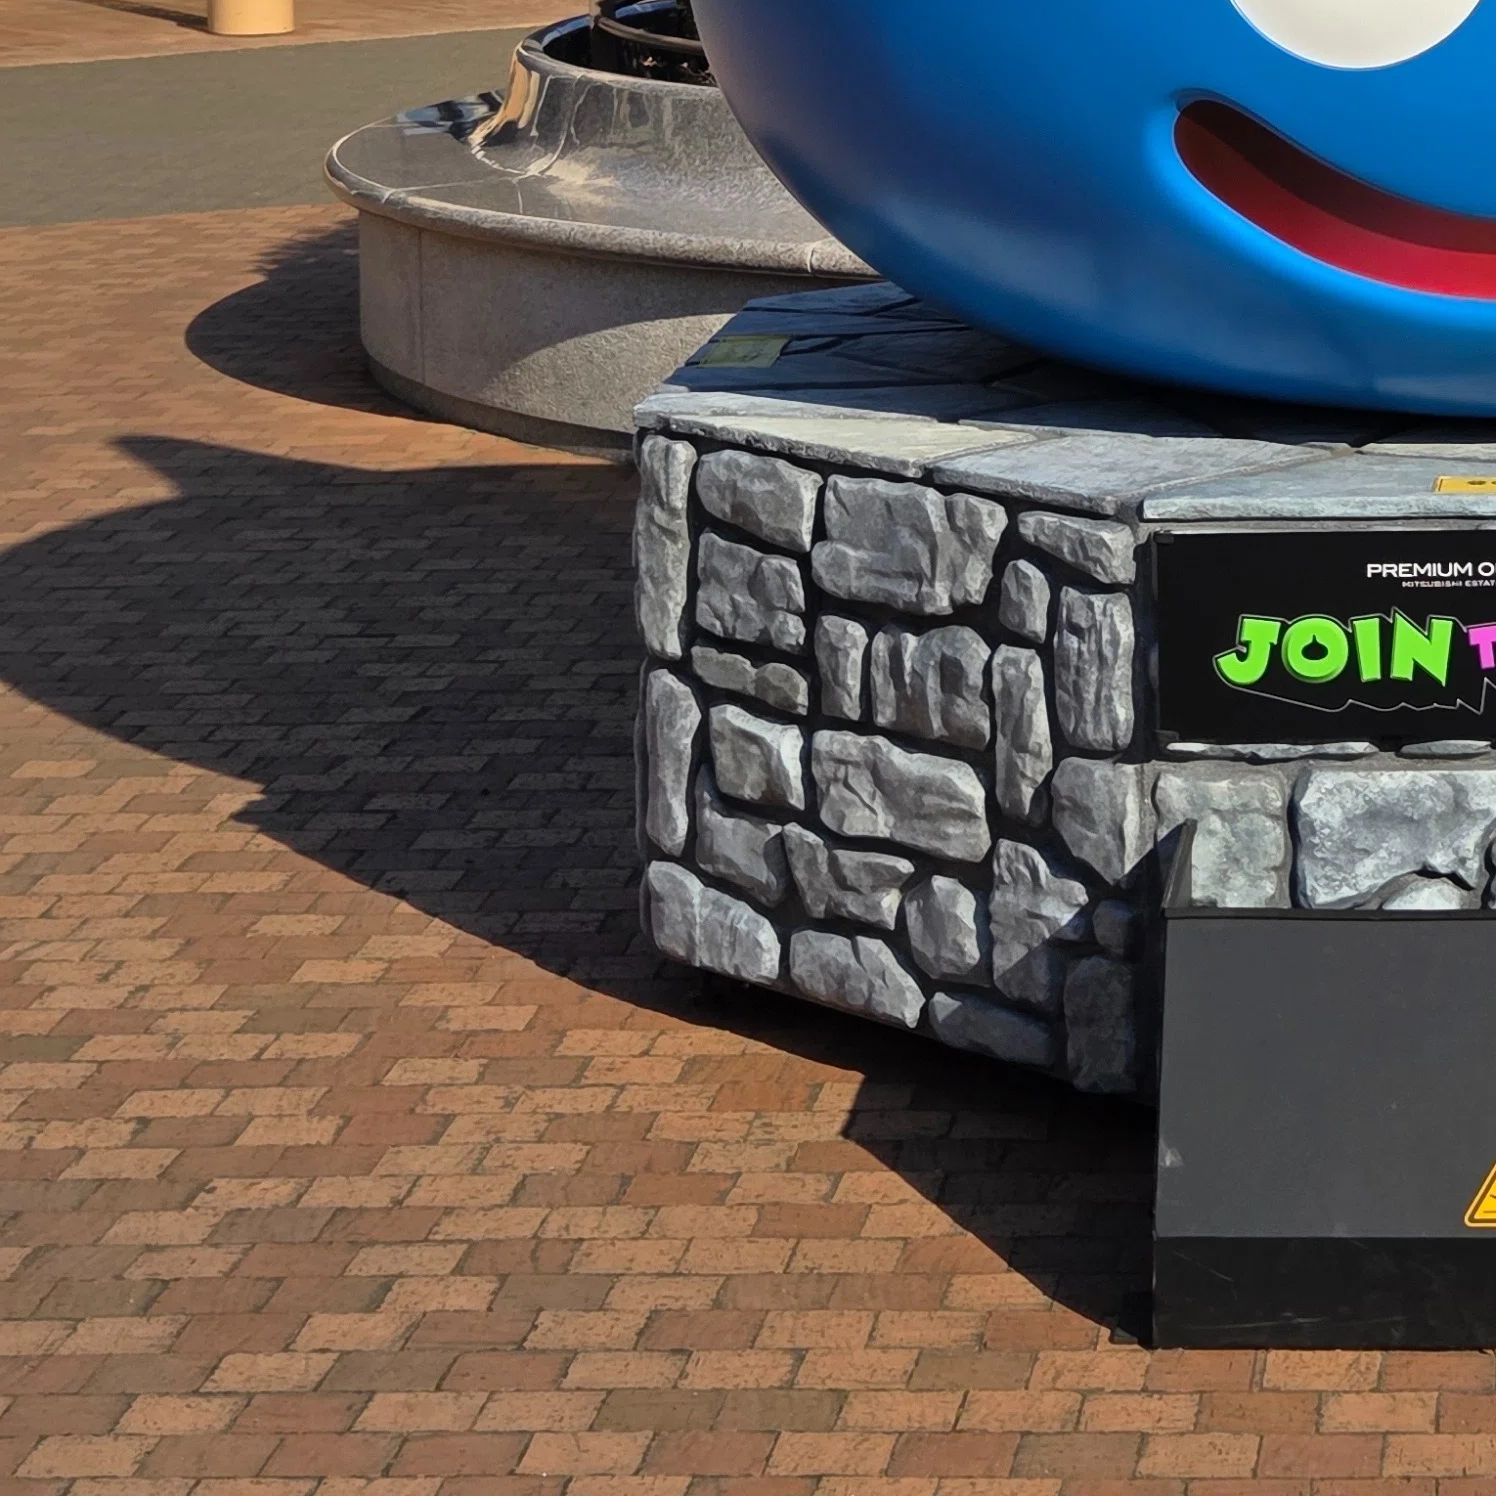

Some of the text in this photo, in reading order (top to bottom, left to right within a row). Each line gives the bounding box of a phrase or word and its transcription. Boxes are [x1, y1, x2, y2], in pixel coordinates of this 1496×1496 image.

[1366, 562, 1474, 578] PREMIUM
[1402, 580, 1463, 588] MITSUBISHI
[1216, 611, 1453, 687] JOIN
